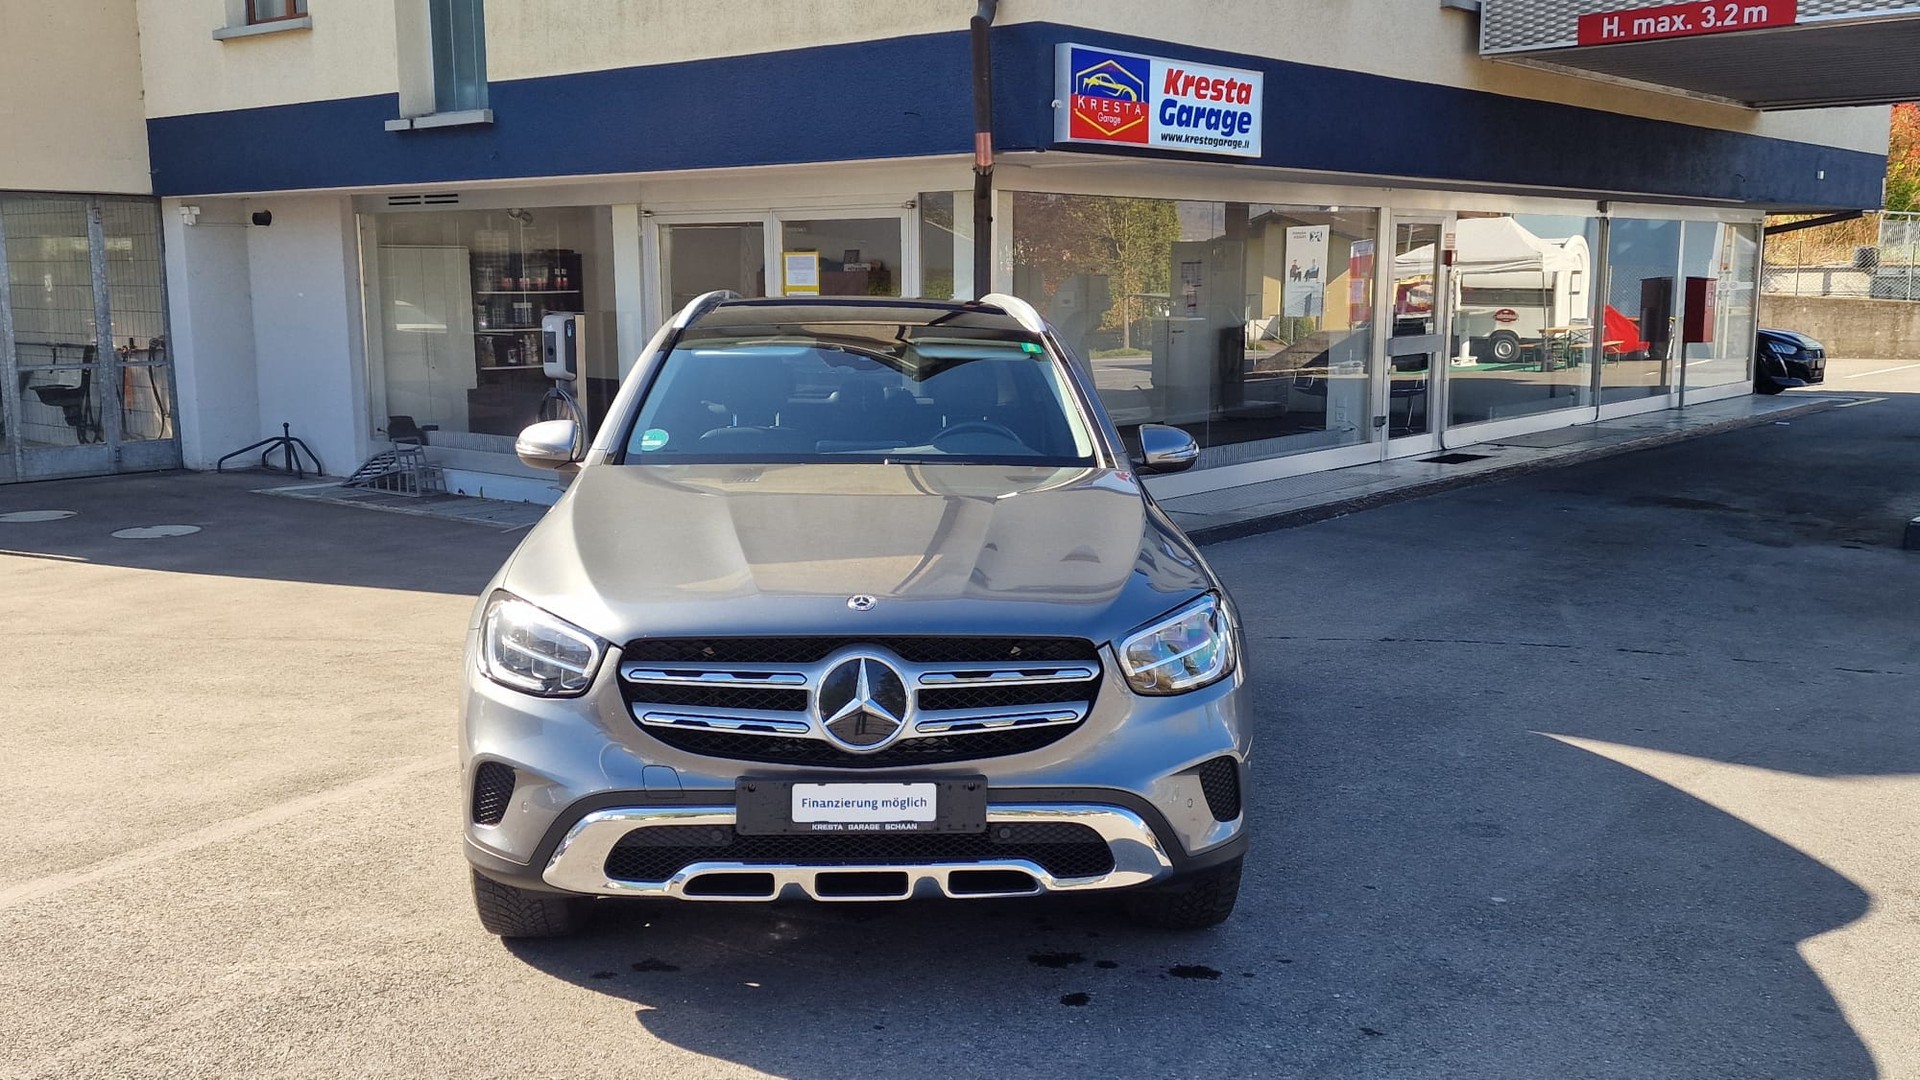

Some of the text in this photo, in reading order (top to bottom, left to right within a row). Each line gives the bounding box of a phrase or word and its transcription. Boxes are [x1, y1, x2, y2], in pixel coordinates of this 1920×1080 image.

[1602, 3, 1768, 38] H. max. 3.2 m
[1163, 68, 1253, 105] Kresta
[1077, 95, 1142, 116] KRESTA
[1097, 112, 1122, 127] Garage
[1159, 98, 1252, 136] Garage
[1160, 132, 1250, 150] www.krestagarage.li
[801, 797, 927, 810] Finanzierung möglich
[811, 823, 843, 831] KRESTA
[847, 823, 881, 831] GARAGE
